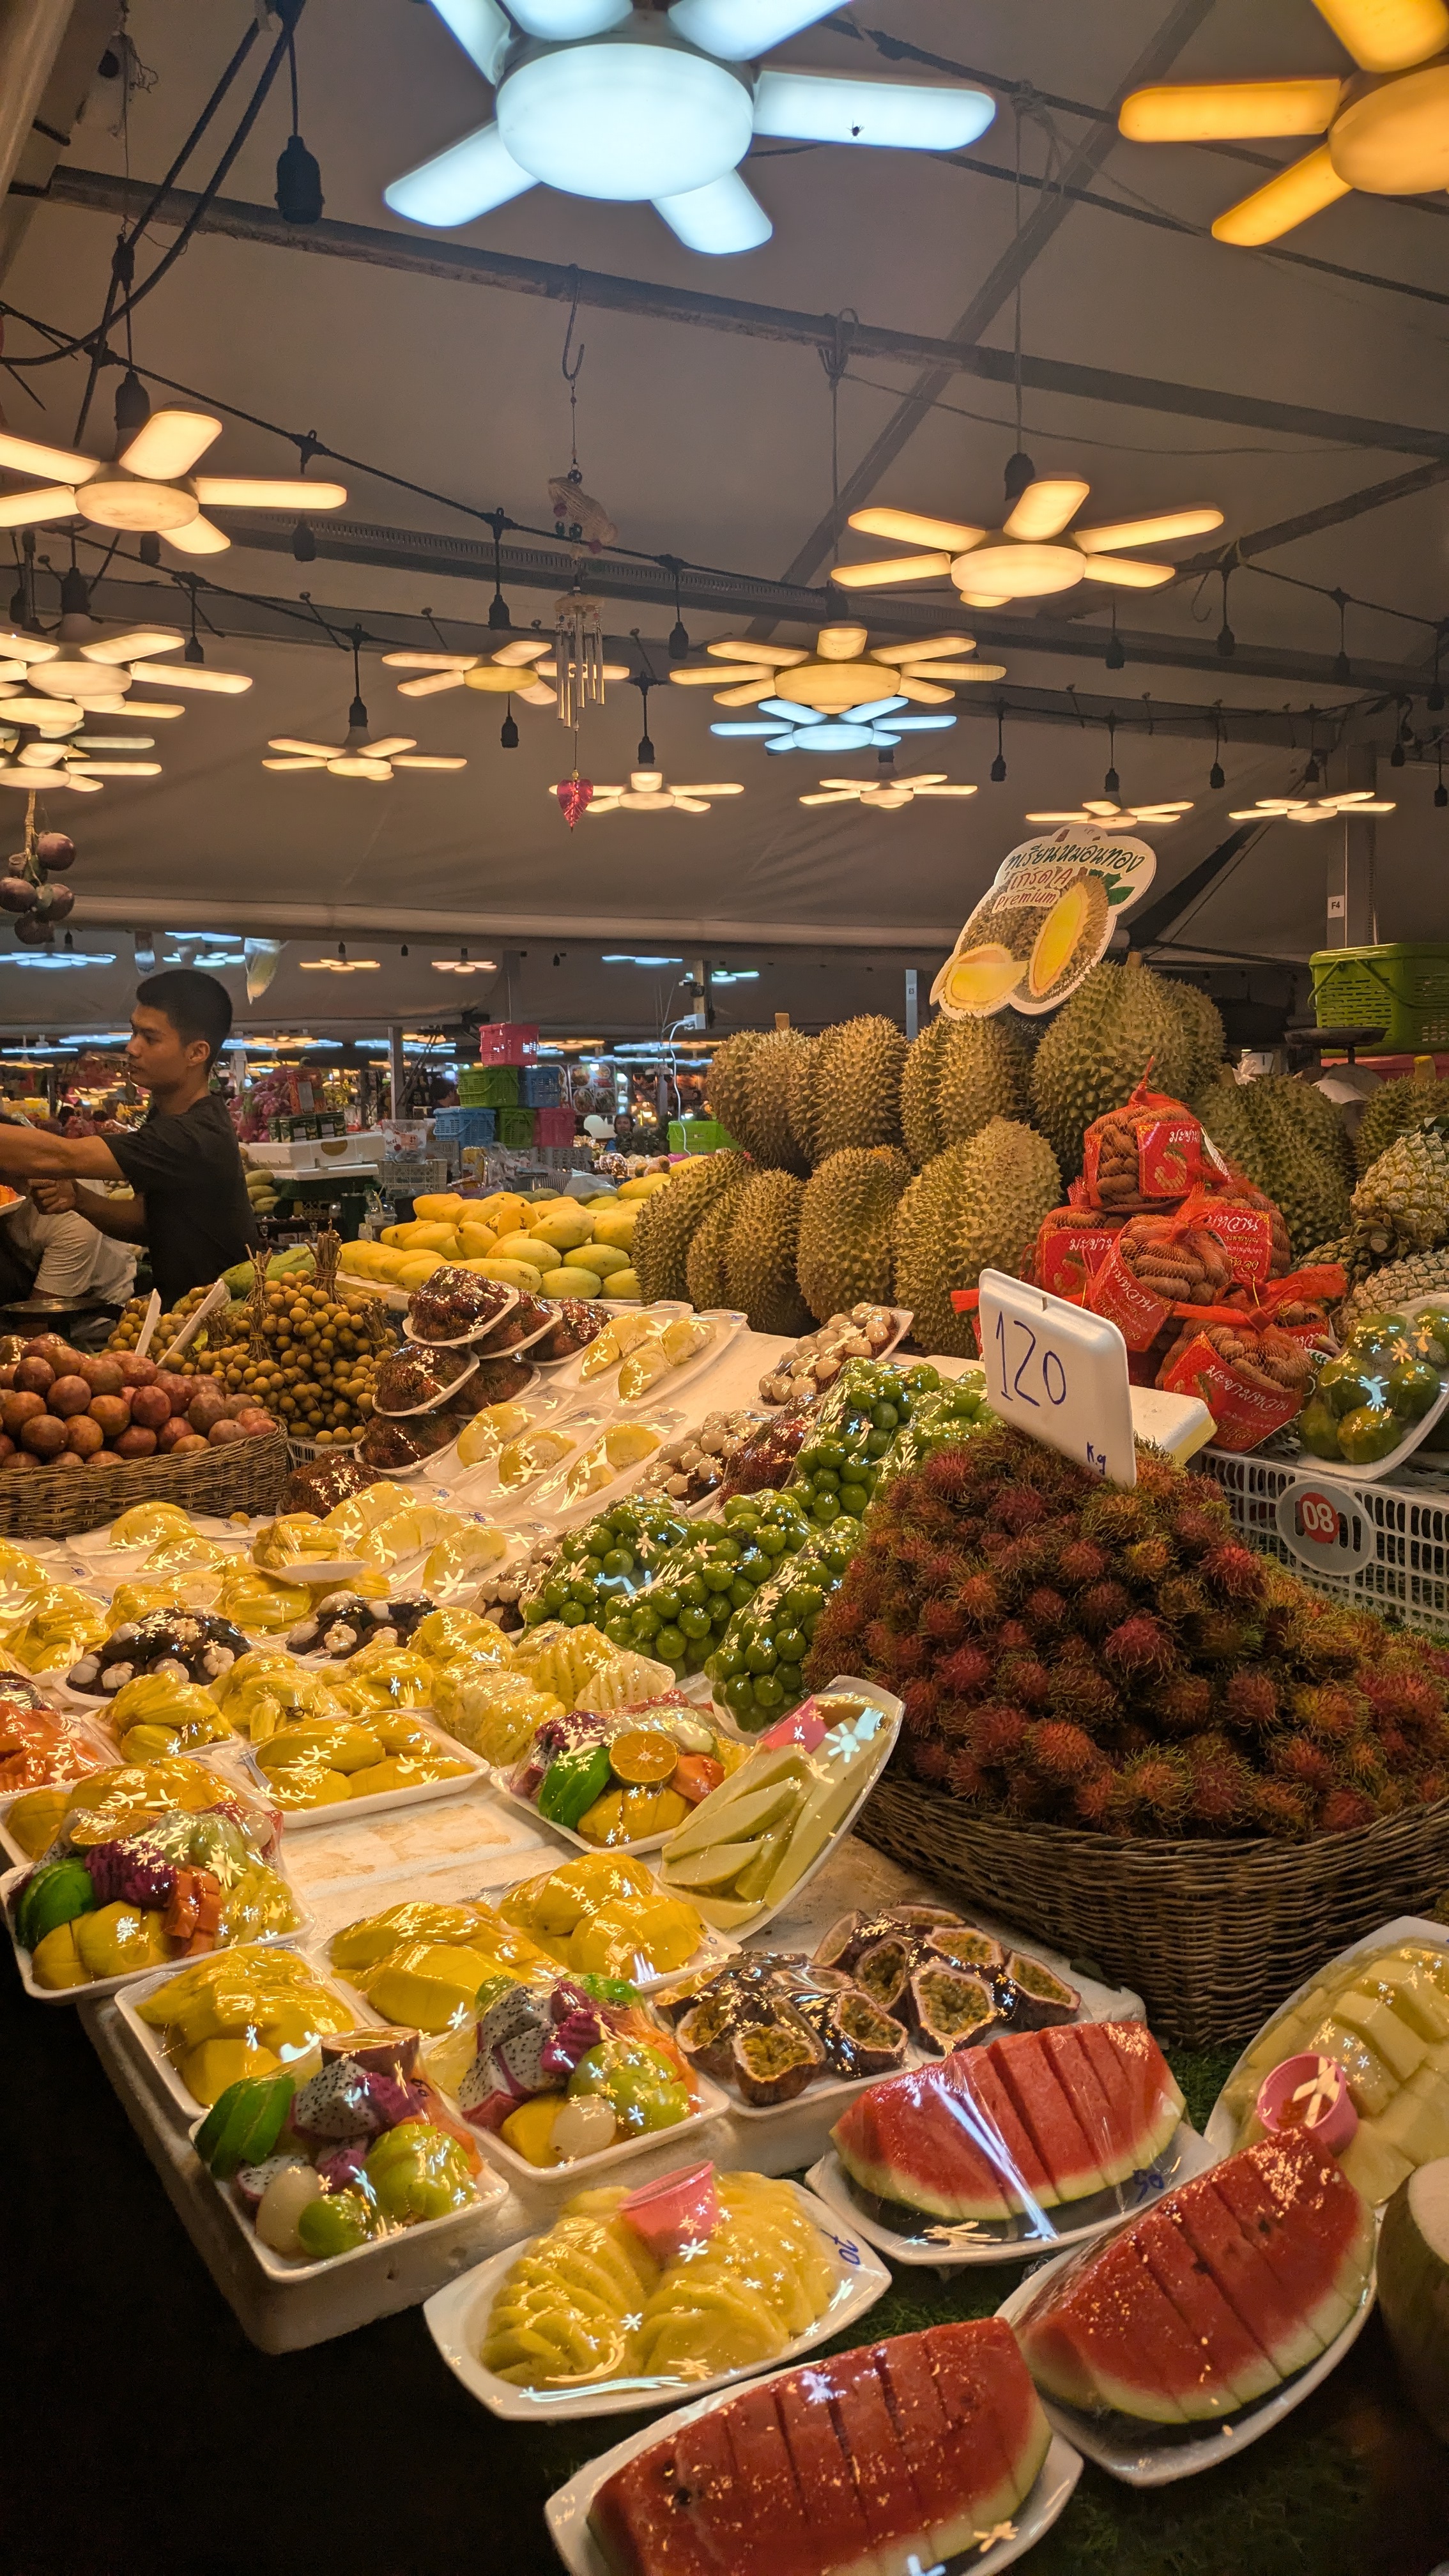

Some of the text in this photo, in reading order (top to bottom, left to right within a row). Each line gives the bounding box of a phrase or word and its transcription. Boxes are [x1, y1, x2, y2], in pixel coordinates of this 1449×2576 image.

[1011, 868, 1073, 890] เกรด A
[1331, 901, 1340, 910] F4
[996, 1311, 1066, 1407] 120
[1302, 1500, 1335, 1533] 08
